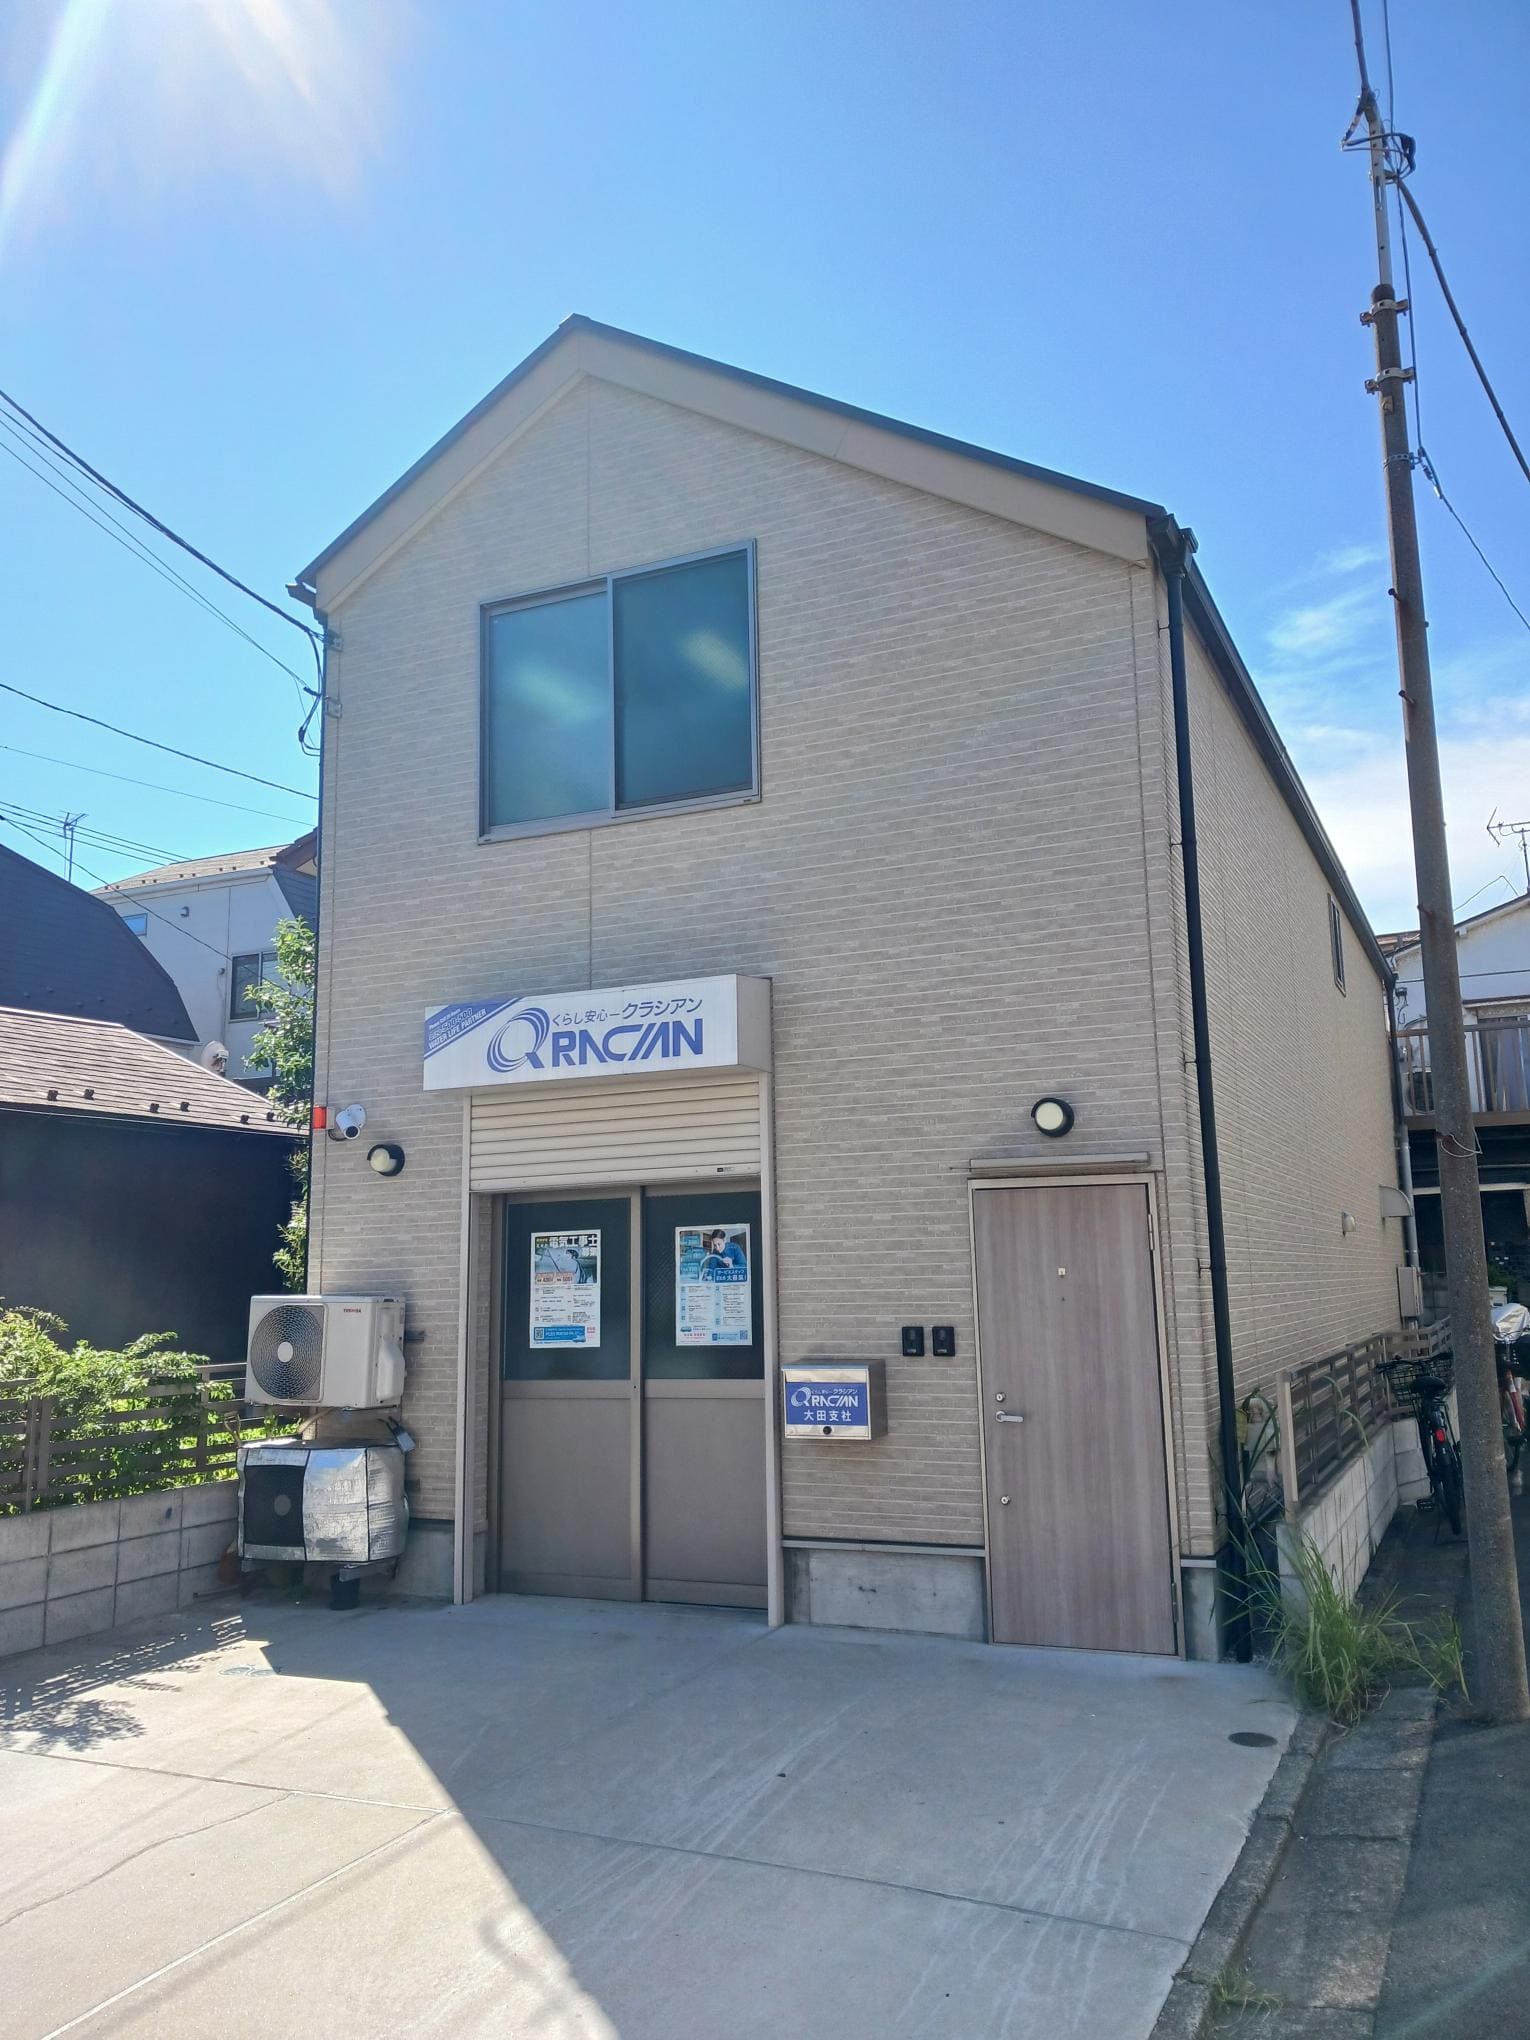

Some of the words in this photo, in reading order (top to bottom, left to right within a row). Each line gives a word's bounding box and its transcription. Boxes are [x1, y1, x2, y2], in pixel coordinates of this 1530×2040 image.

[428, 1033, 448, 1049] WATER
[448, 1024, 460, 1038] LIFE
[461, 1008, 487, 1030] PARTNER
[803, 1409, 852, 1422] 大田支社
